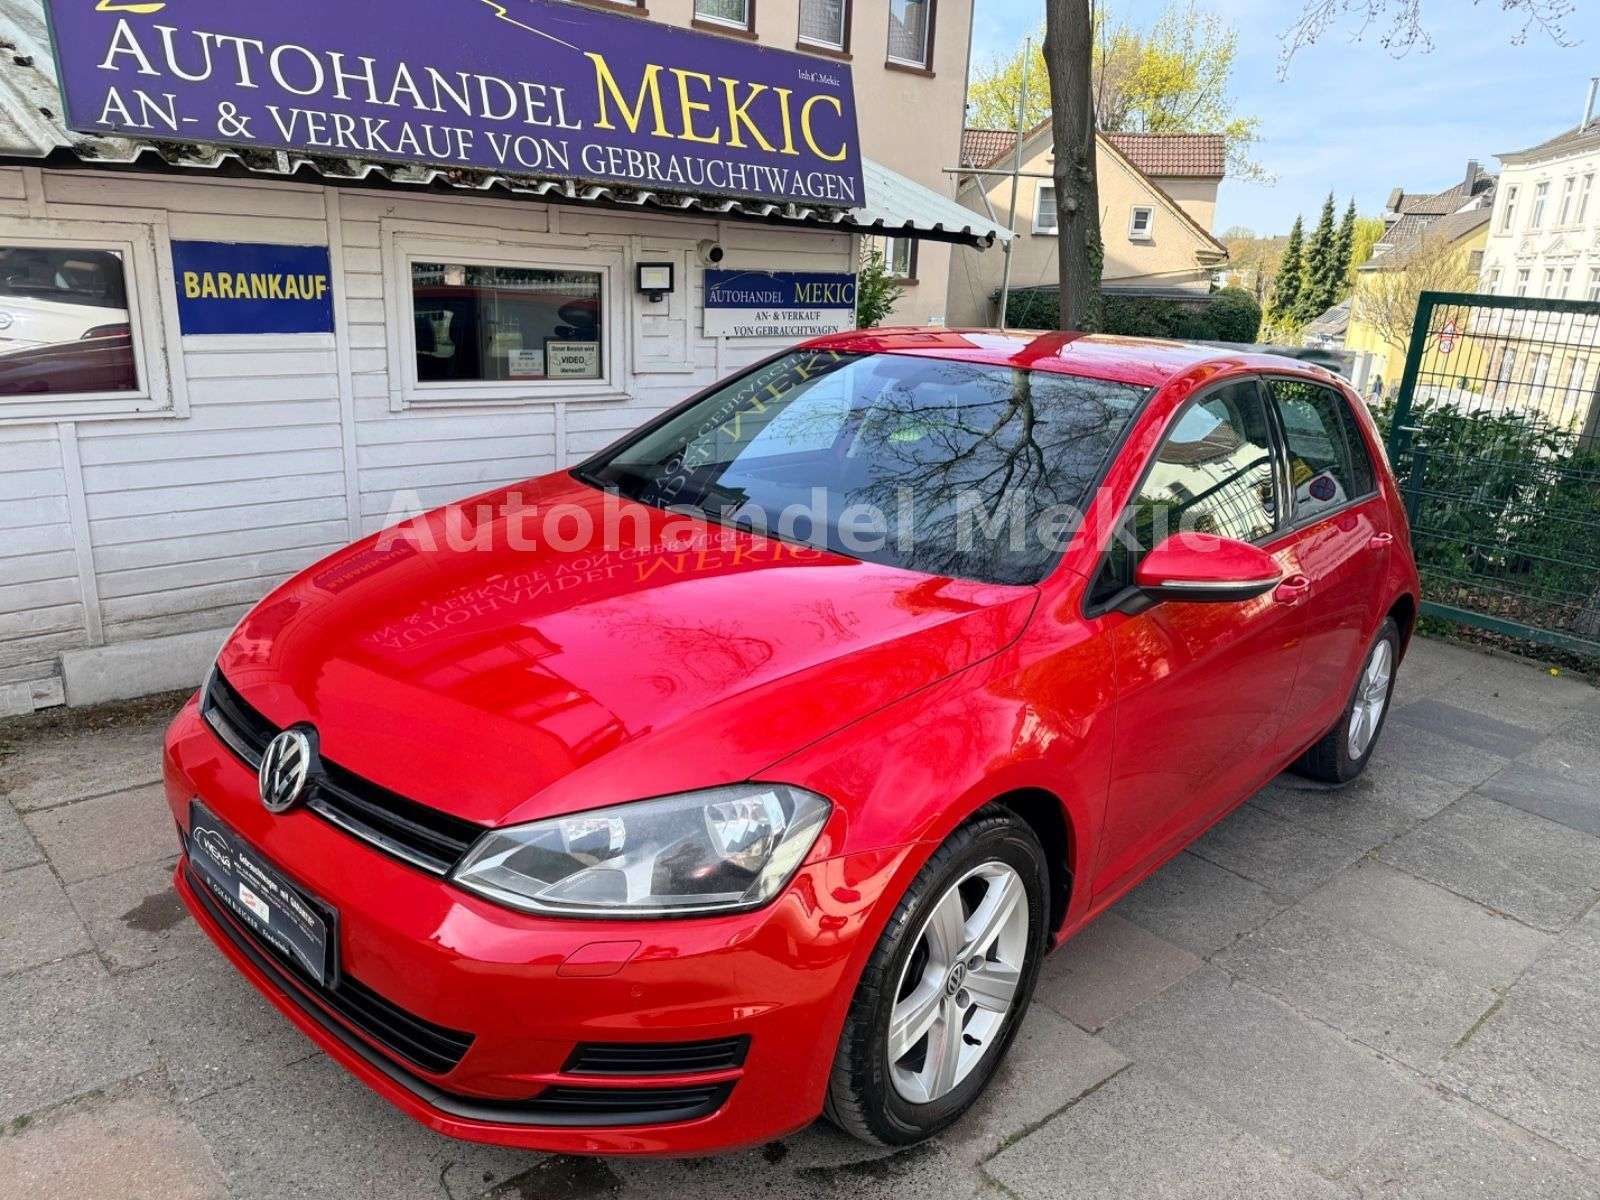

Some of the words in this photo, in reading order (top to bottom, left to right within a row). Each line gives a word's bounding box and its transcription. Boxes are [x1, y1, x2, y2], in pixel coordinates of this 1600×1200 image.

[97, 18, 582, 131] AUTOHANDEL
[584, 52, 847, 162] MEKIC
[96, 86, 198, 131] AN-
[217, 101, 256, 139] &
[265, 104, 474, 161] VERKAUF
[485, 131, 570, 170] VON
[581, 143, 855, 201] GEBRAUCHTWAGEN
[183, 270, 327, 300] BARANKAUF
[709, 289, 784, 303] AUTOHANDEL
[794, 282, 855, 304] MEKIC
[774, 312, 781, 321] &
[782, 311, 821, 321] VERKAUF
[734, 325, 754, 336] VON
[756, 325, 839, 336] GEBRAUCHTWAGEN
[561, 356, 584, 364] VIDEO
